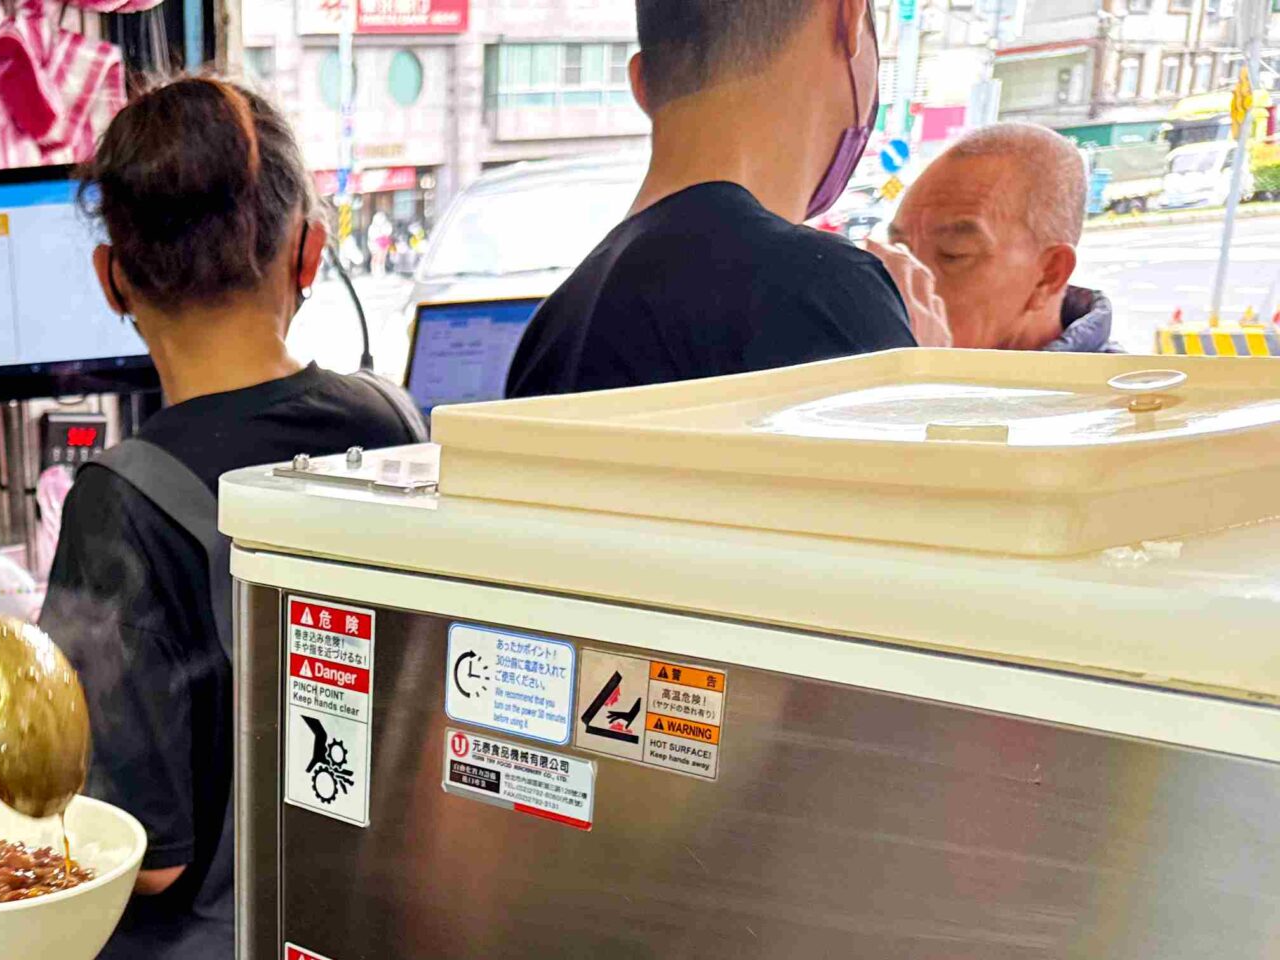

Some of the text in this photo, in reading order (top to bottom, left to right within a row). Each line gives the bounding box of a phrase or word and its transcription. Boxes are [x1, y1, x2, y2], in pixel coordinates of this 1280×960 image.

[315, 663, 357, 687] Danger
[293, 681, 344, 701] PINCH POINT
[293, 693, 359, 717] Keep hands clear
[667, 720, 712, 740] WARNING
[649, 738, 712, 759] HOT SURFACE!
[649, 750, 711, 771] Keep hands away
